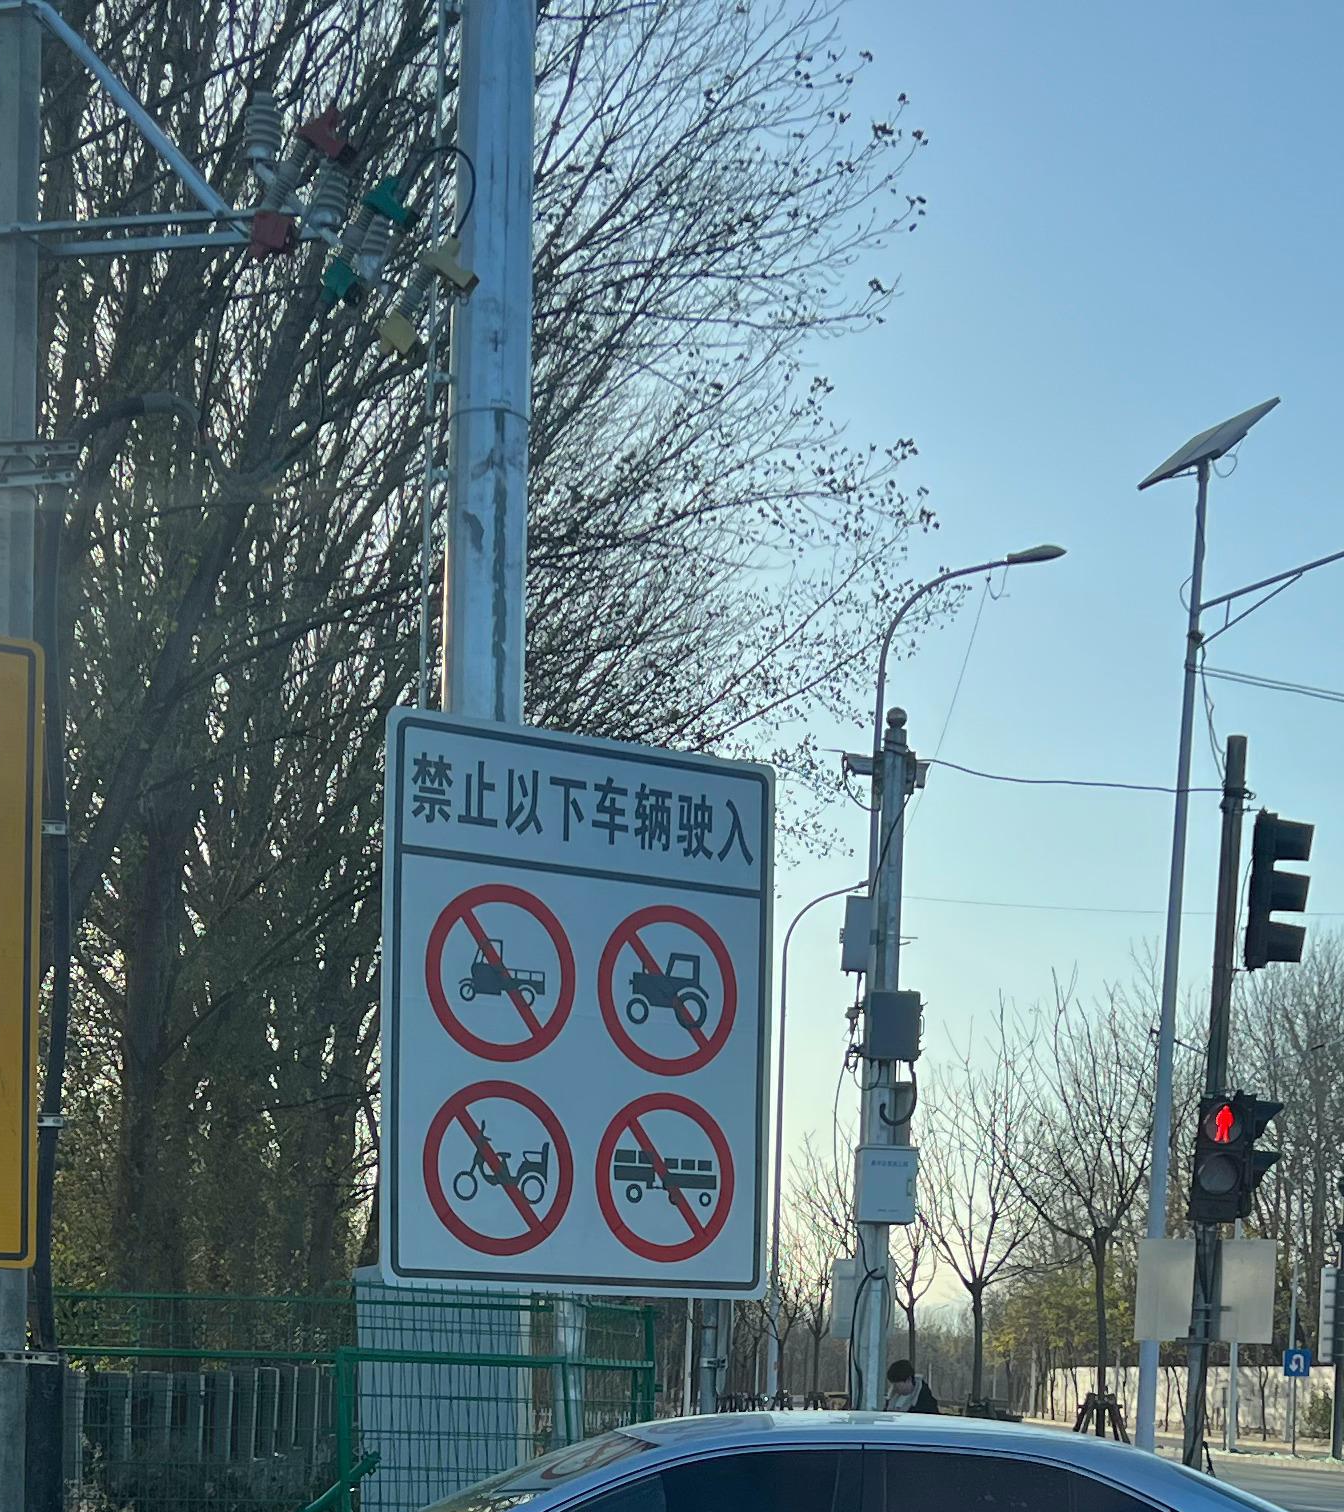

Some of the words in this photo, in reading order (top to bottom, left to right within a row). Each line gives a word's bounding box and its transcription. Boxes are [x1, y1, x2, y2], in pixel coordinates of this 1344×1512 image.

[411, 752, 754, 866] 禁止以下车辆驶入
